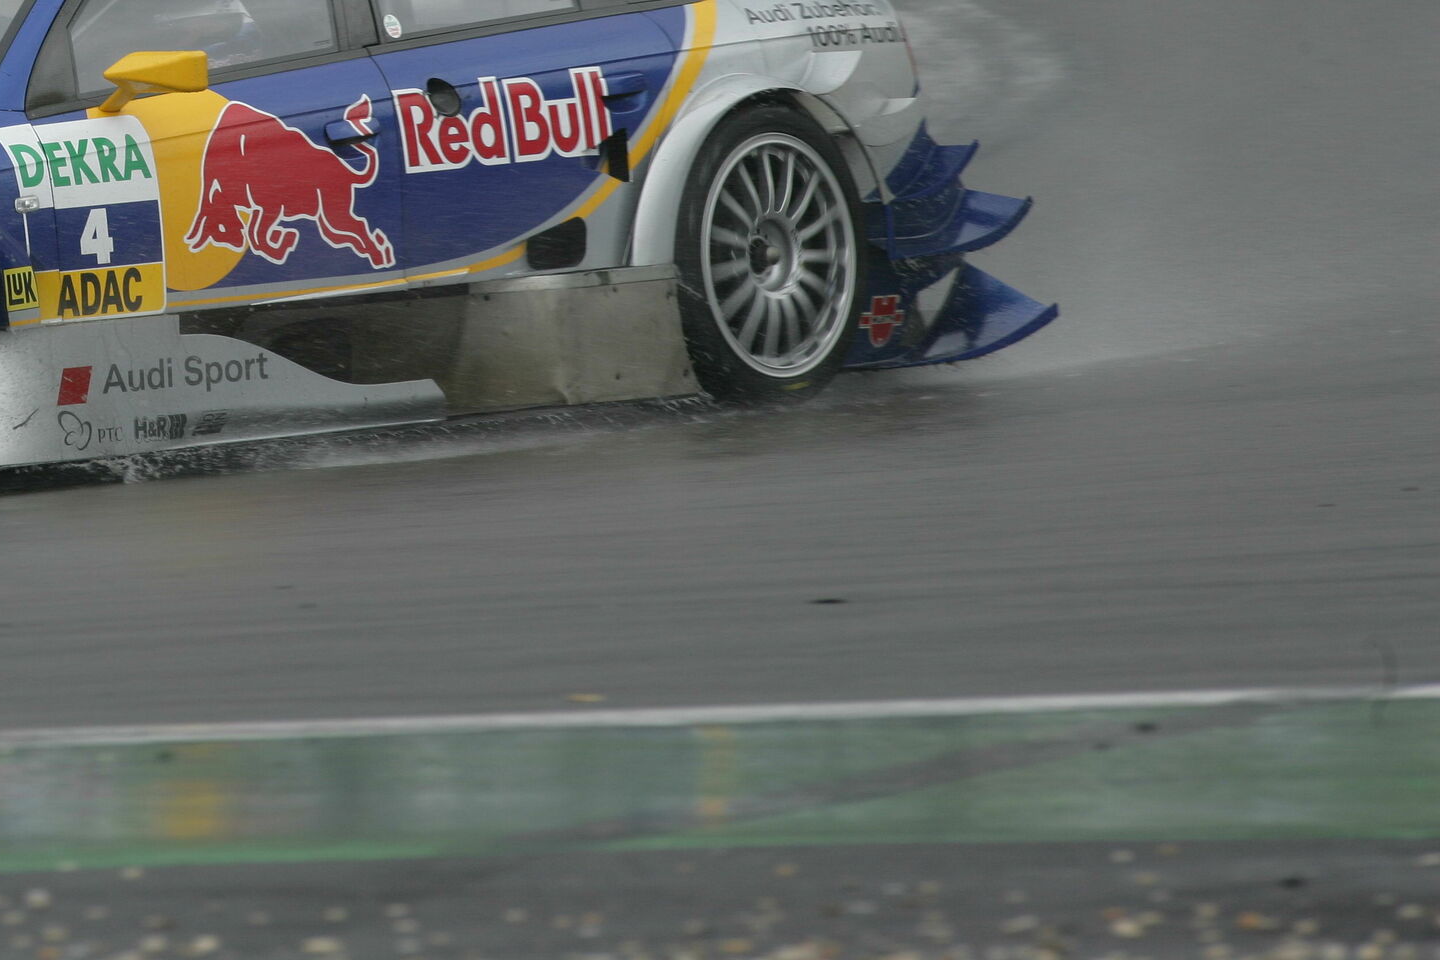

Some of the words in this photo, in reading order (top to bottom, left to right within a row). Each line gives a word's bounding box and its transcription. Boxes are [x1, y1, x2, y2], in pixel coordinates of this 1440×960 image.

[744, 5, 795, 24] Audi
[807, 24, 858, 47] 100%
[393, 77, 509, 173] Red
[503, 67, 612, 162] Bull
[8, 134, 152, 188] DEKRA
[80, 208, 114, 265] 4
[57, 267, 143, 317] ADAC
[102, 357, 173, 394] Audi
[184, 352, 269, 392] Sport
[134, 415, 171, 440] H&R
